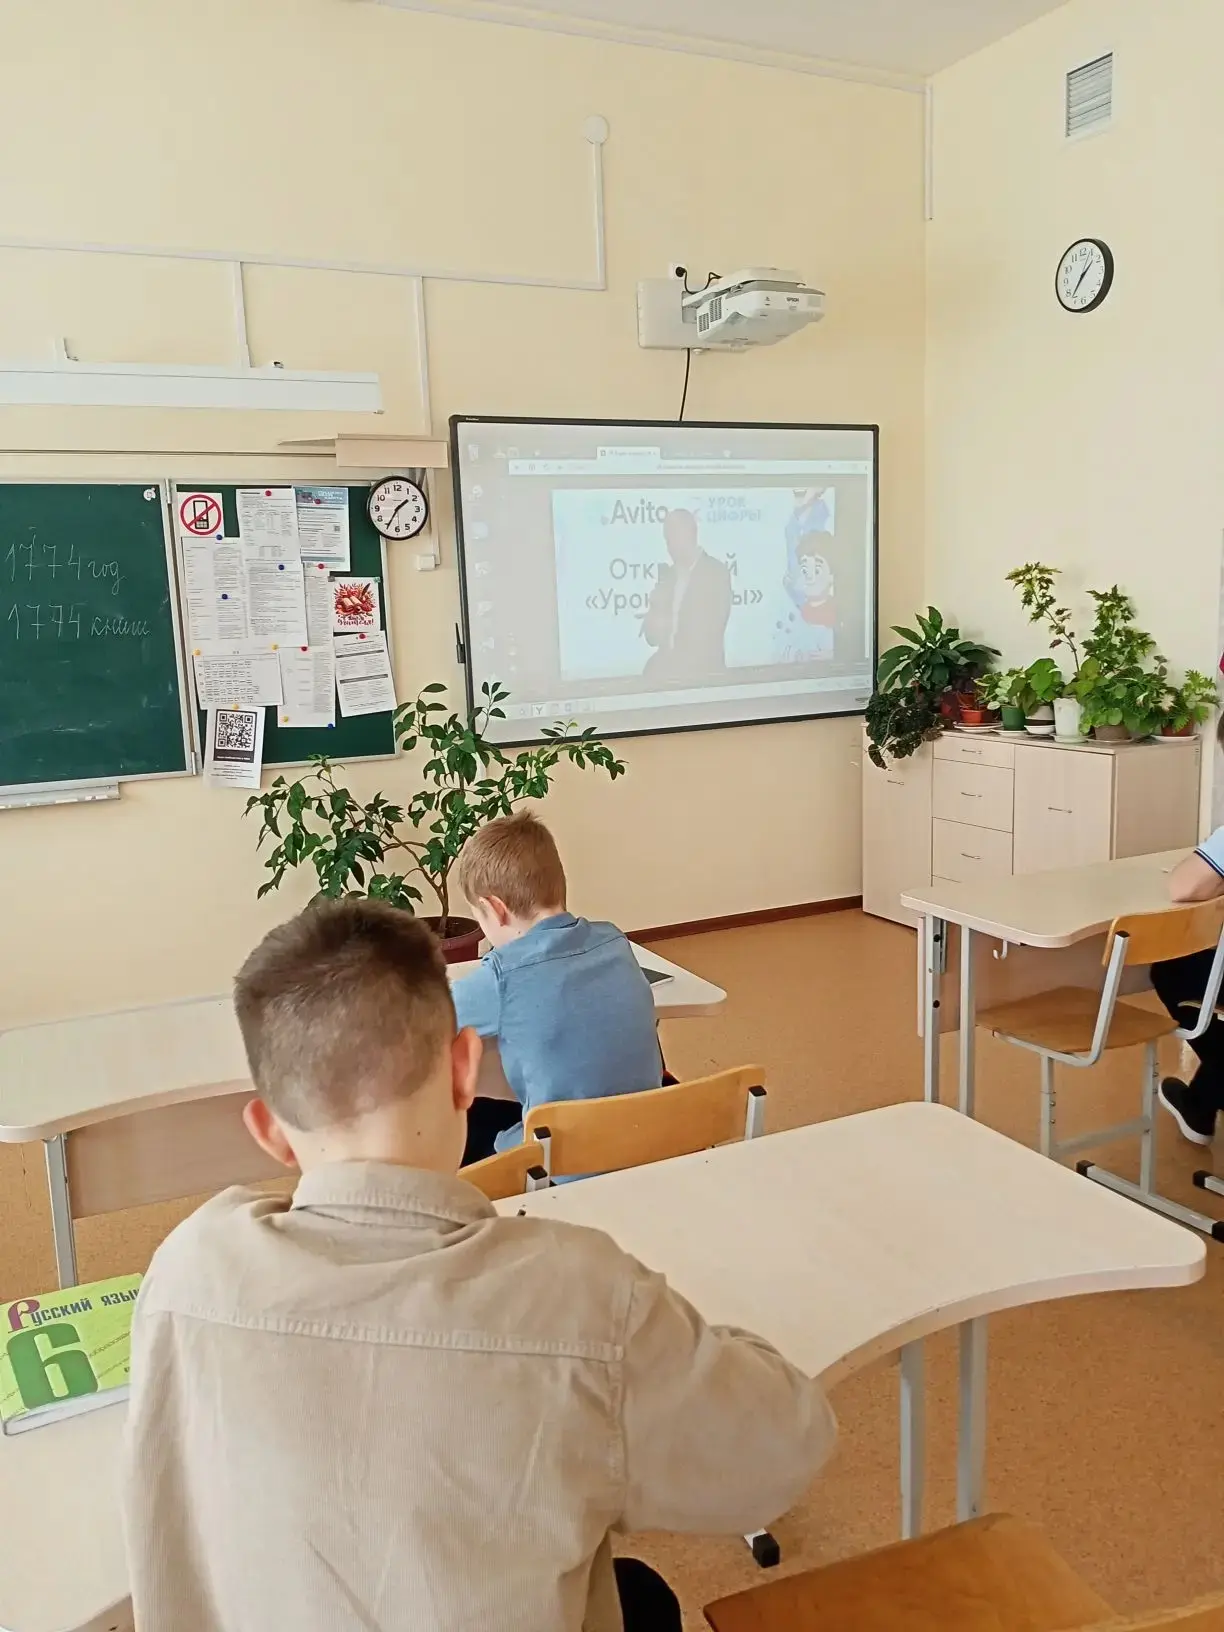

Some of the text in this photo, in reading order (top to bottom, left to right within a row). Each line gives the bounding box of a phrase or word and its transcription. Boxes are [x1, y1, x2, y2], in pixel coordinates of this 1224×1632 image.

[1071, 254, 1077, 262] 11
[1080, 247, 1087, 256] 12
[1095, 255, 1101, 263] 2
[610, 498, 669, 524] Avito
[5, 540, 127, 595] 1774 год
[8, 603, 81, 640] 1774
[7, 1297, 93, 1334] Русский
[6, 1322, 99, 1410] 6
